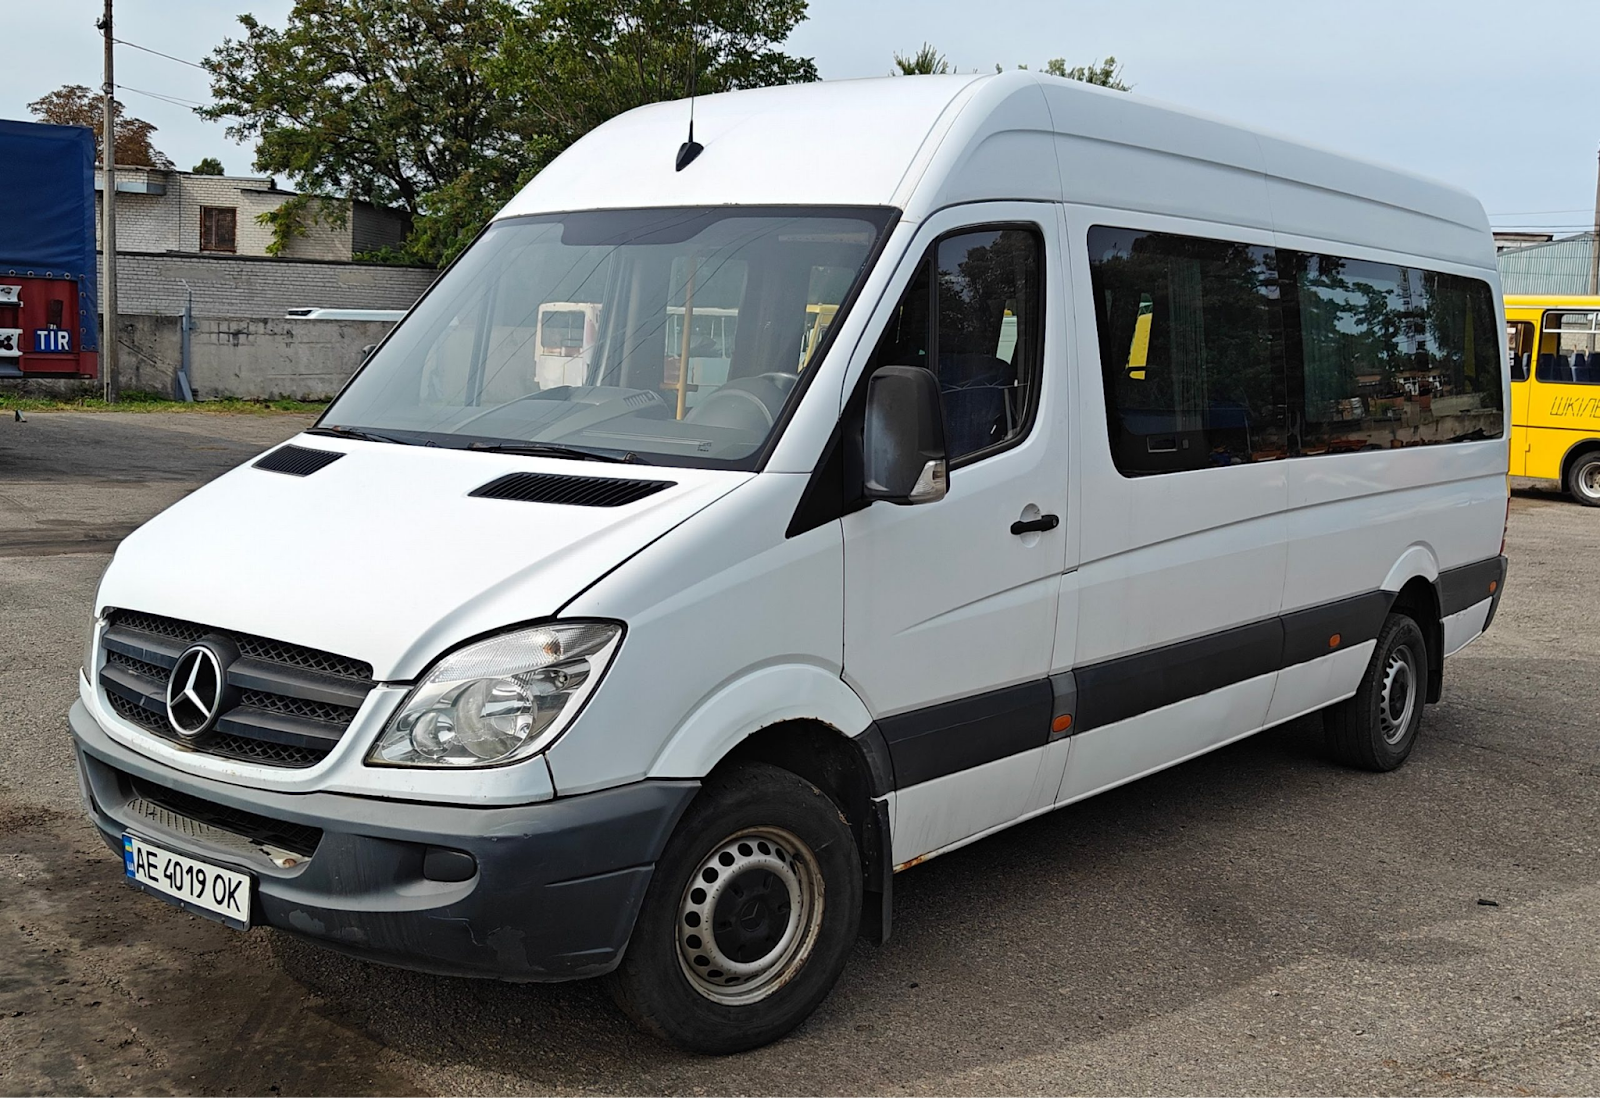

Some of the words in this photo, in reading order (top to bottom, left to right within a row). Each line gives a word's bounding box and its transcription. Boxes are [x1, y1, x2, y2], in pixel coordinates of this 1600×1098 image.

[36, 330, 69, 350] TIR
[136, 846, 159, 883] AE
[163, 858, 207, 899] 4019
[212, 873, 243, 913] OK
